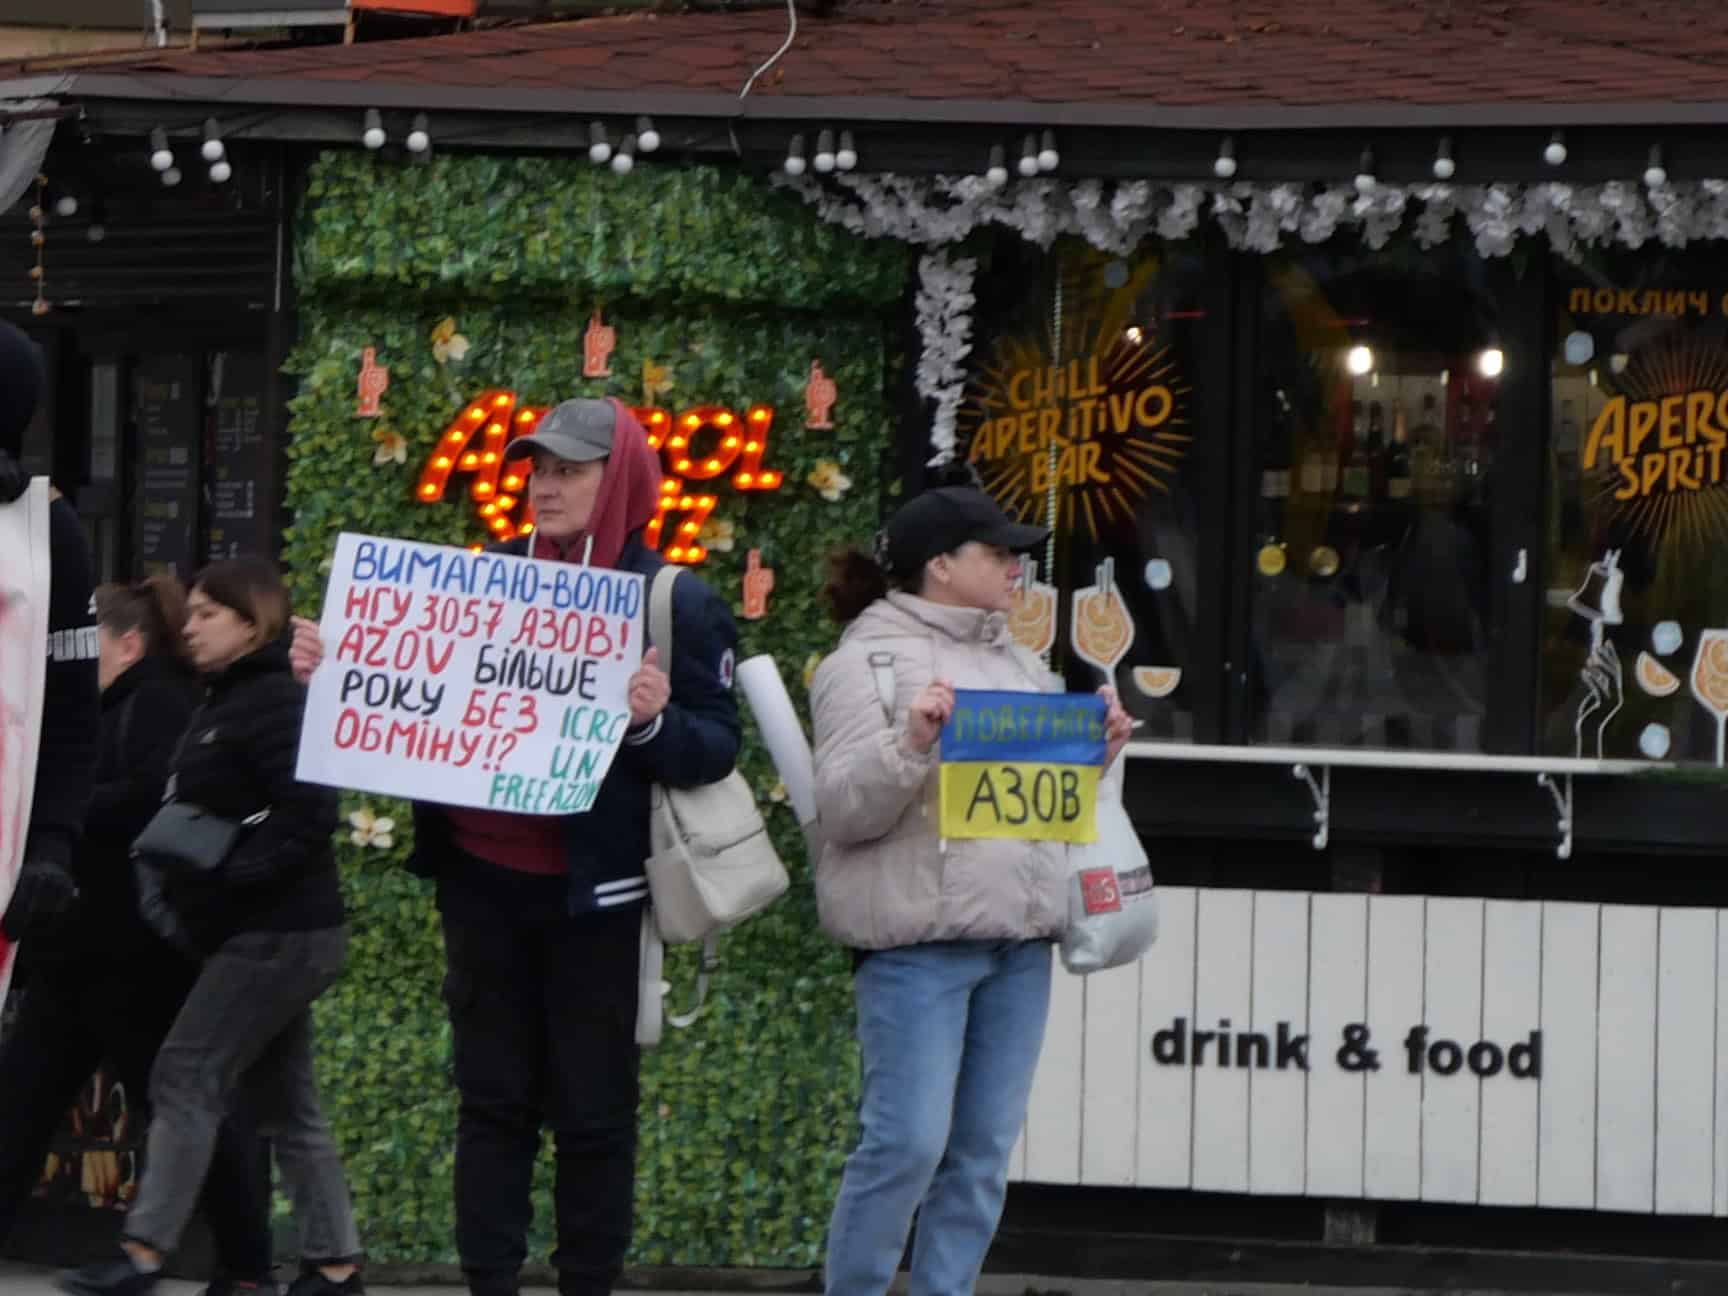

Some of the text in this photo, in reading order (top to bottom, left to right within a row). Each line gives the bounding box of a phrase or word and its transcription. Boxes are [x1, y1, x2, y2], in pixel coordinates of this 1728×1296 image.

[1031, 441, 1110, 494] BAR
[337, 624, 455, 674] AZOV
[345, 586, 629, 661] НГУ 3057 АЗОВ!
[340, 669, 539, 733] РОКУ БЕЗ
[550, 745, 600, 781] UN
[966, 768, 1081, 824] АЗОВ
[1151, 1017, 1543, 1079] drink & food
